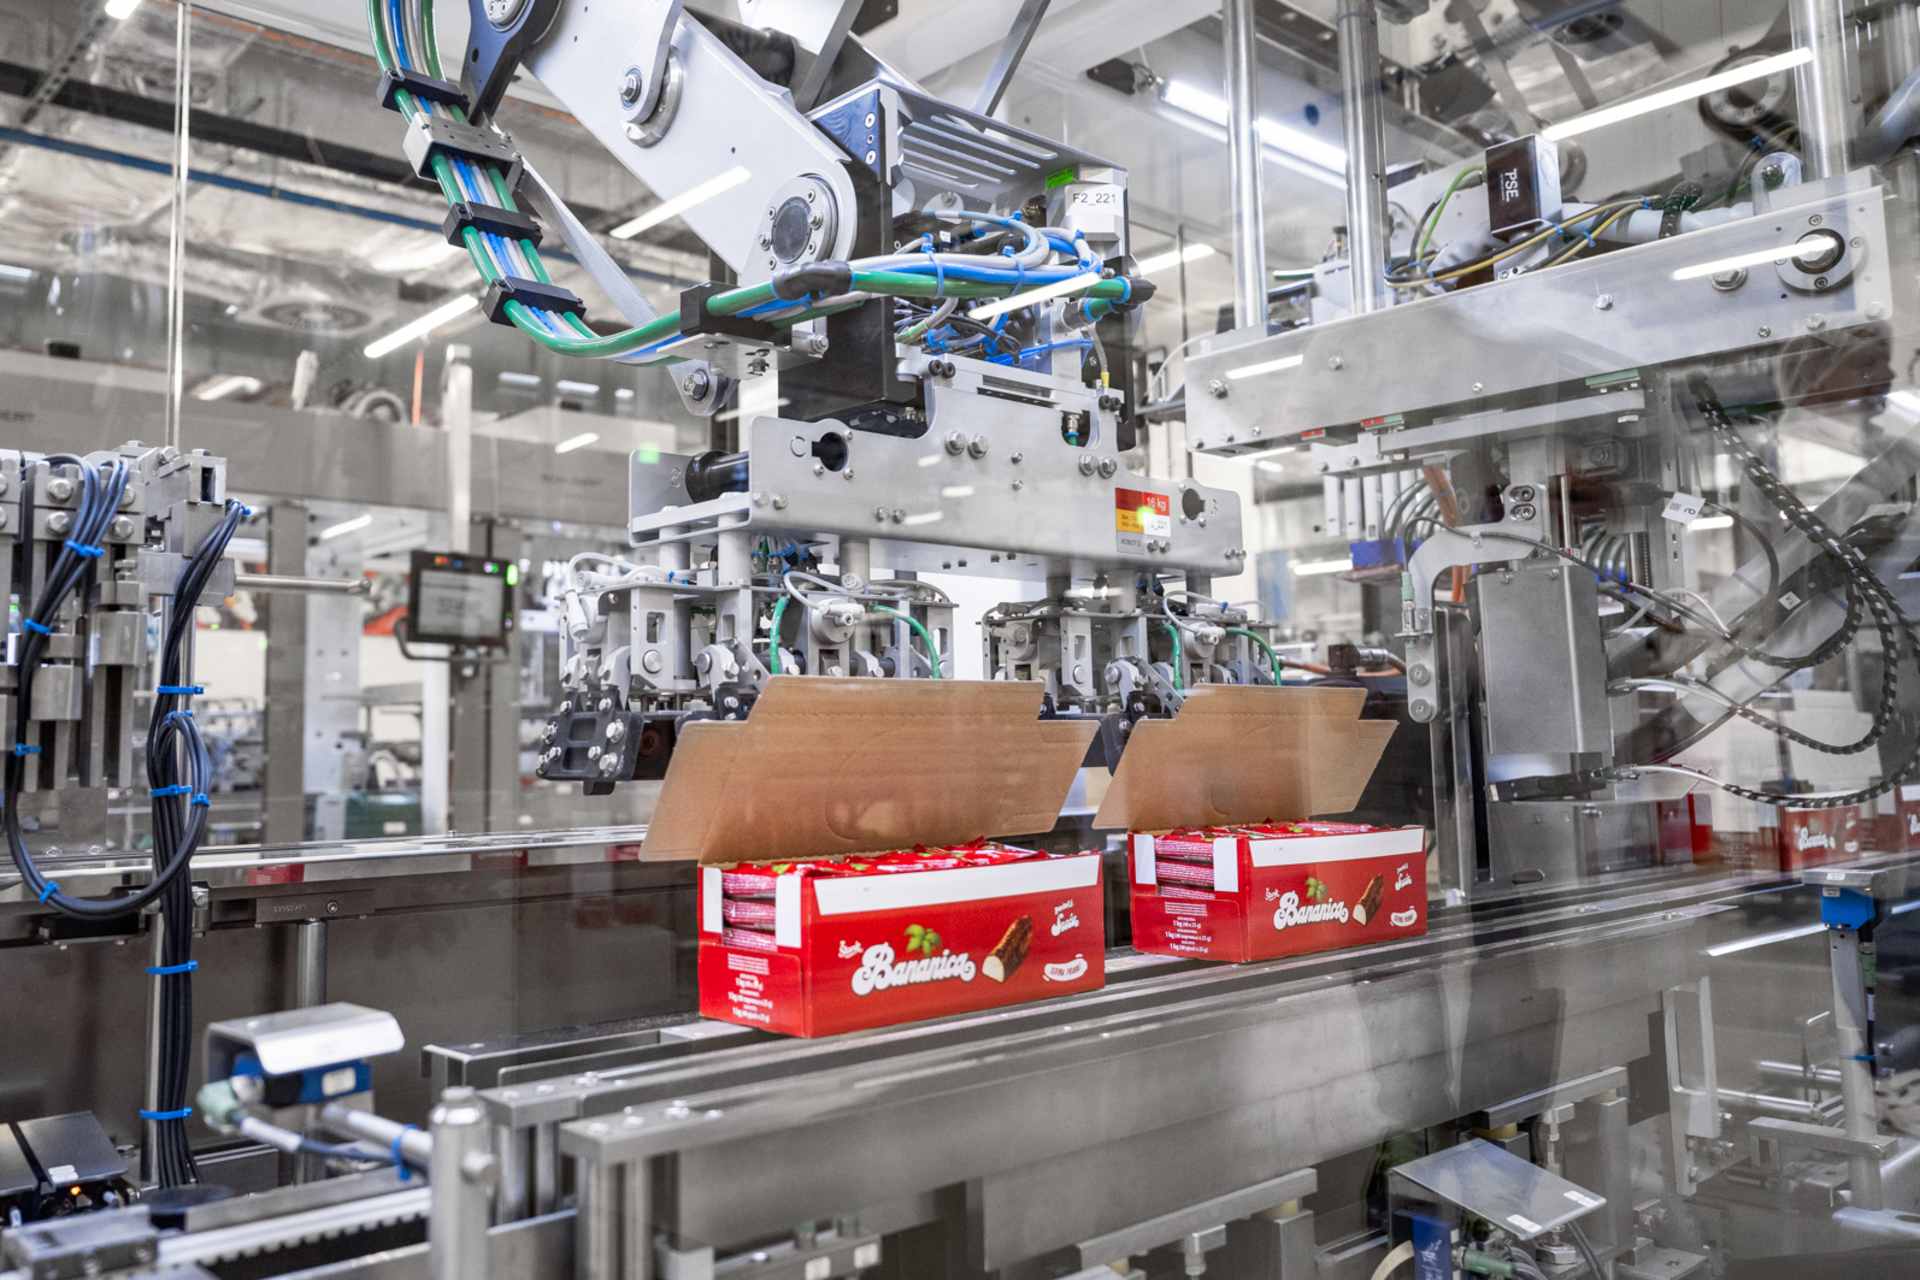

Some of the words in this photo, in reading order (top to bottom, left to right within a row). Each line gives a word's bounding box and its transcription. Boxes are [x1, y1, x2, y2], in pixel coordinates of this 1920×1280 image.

[1072, 192, 1116, 206] F2_221
[1504, 168, 1519, 202] PSE
[1273, 890, 1350, 930] Bananica
[851, 941, 977, 996] Bananica
